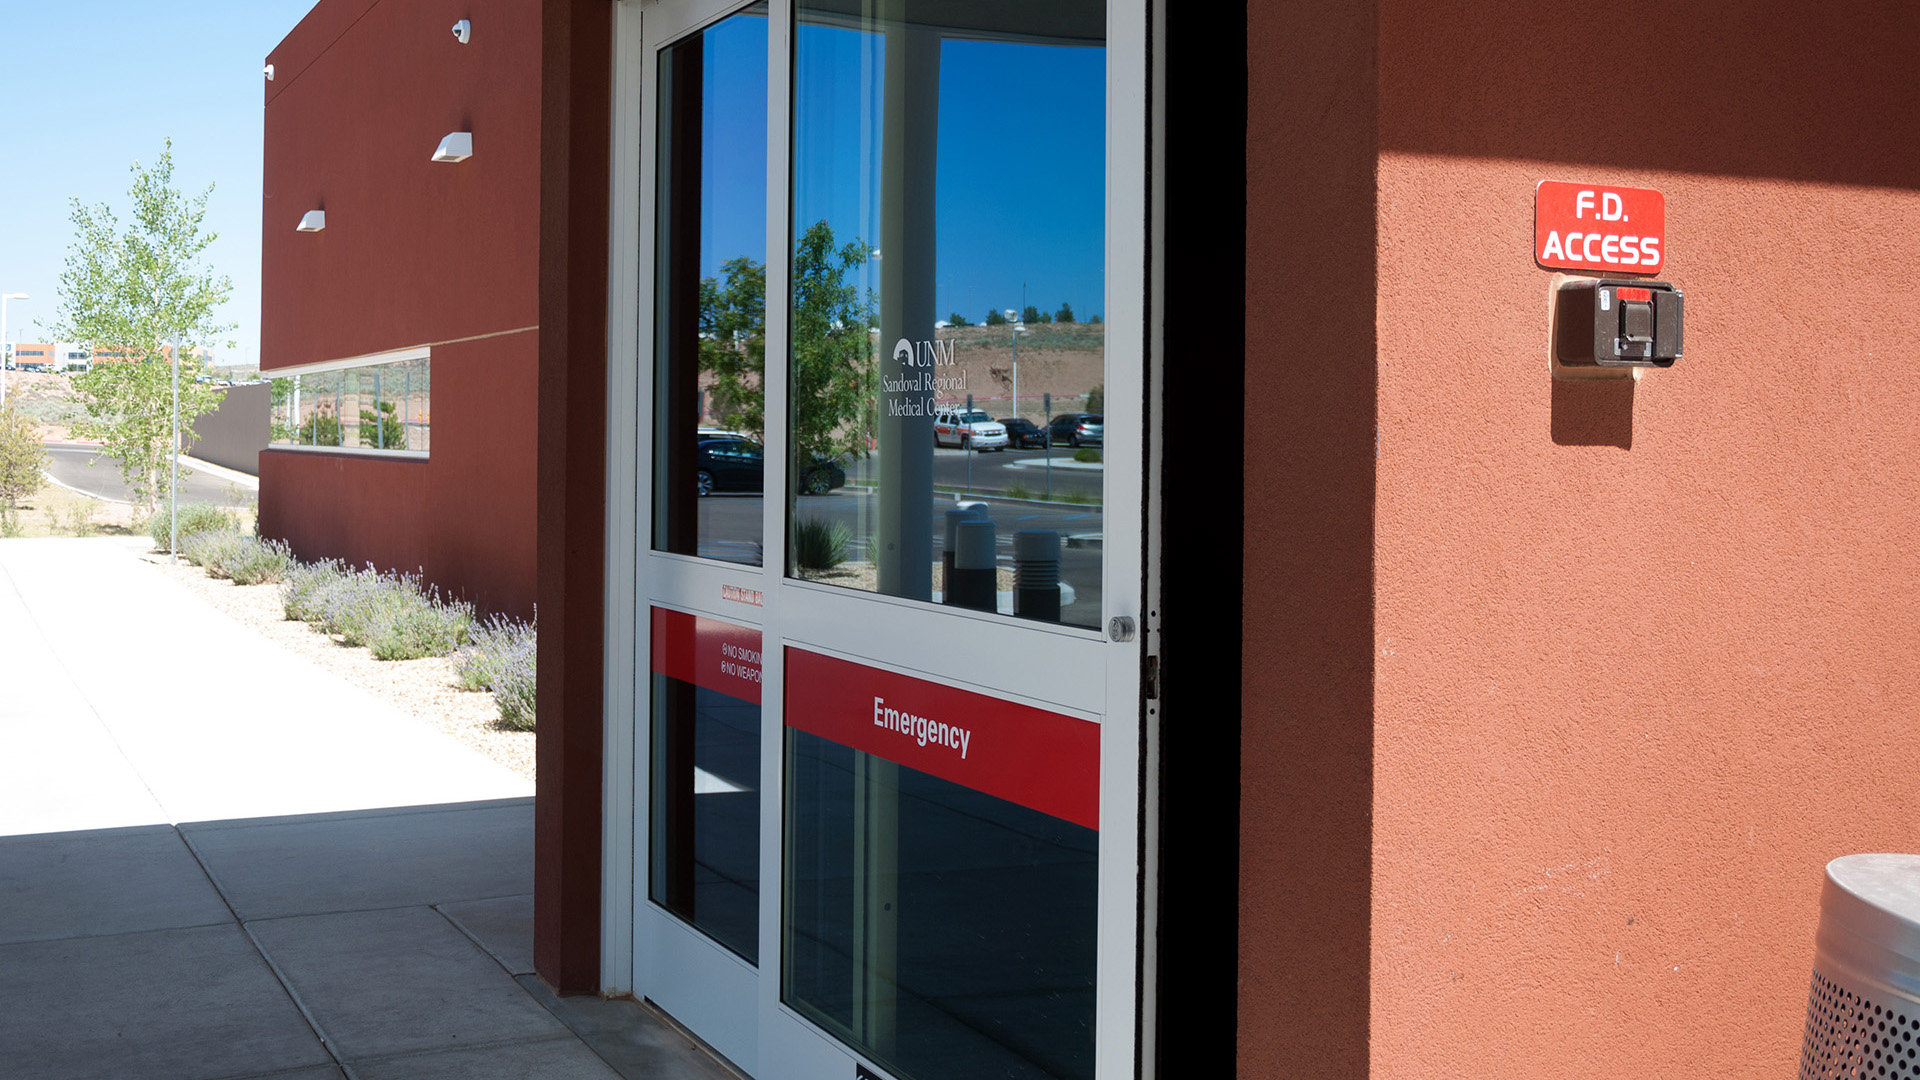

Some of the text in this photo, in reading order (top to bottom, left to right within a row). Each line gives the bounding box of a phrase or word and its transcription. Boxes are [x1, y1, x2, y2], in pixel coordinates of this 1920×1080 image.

[1576, 191, 1628, 222] F.D.
[1542, 231, 1660, 266] ACCESS
[915, 338, 955, 368] UNM
[883, 369, 967, 399] Sandoval Regional
[888, 396, 960, 417] Medical Center
[727, 644, 737, 659] NO
[726, 662, 736, 676] NO
[874, 696, 971, 760] Emergency
